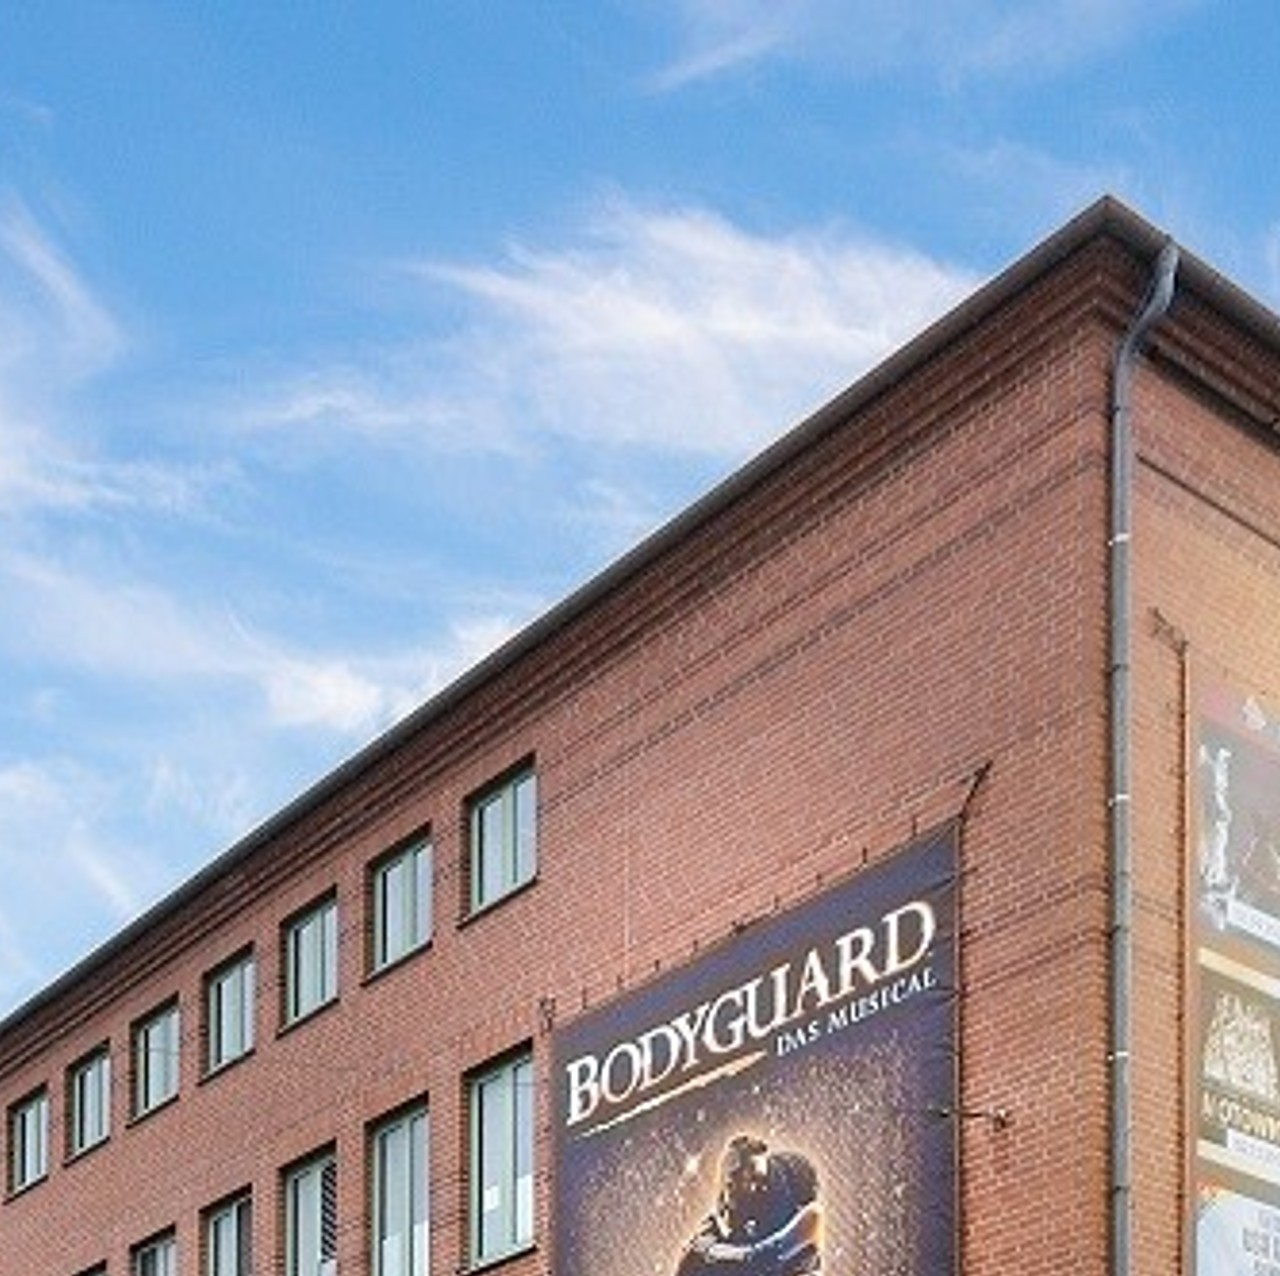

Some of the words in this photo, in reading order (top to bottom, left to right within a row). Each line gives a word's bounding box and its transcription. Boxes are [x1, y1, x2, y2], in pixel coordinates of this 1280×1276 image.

[565, 900, 937, 1127] BODYGUARD
[776, 1022, 822, 1058] DAS
[826, 967, 938, 1035] MUSICAL
